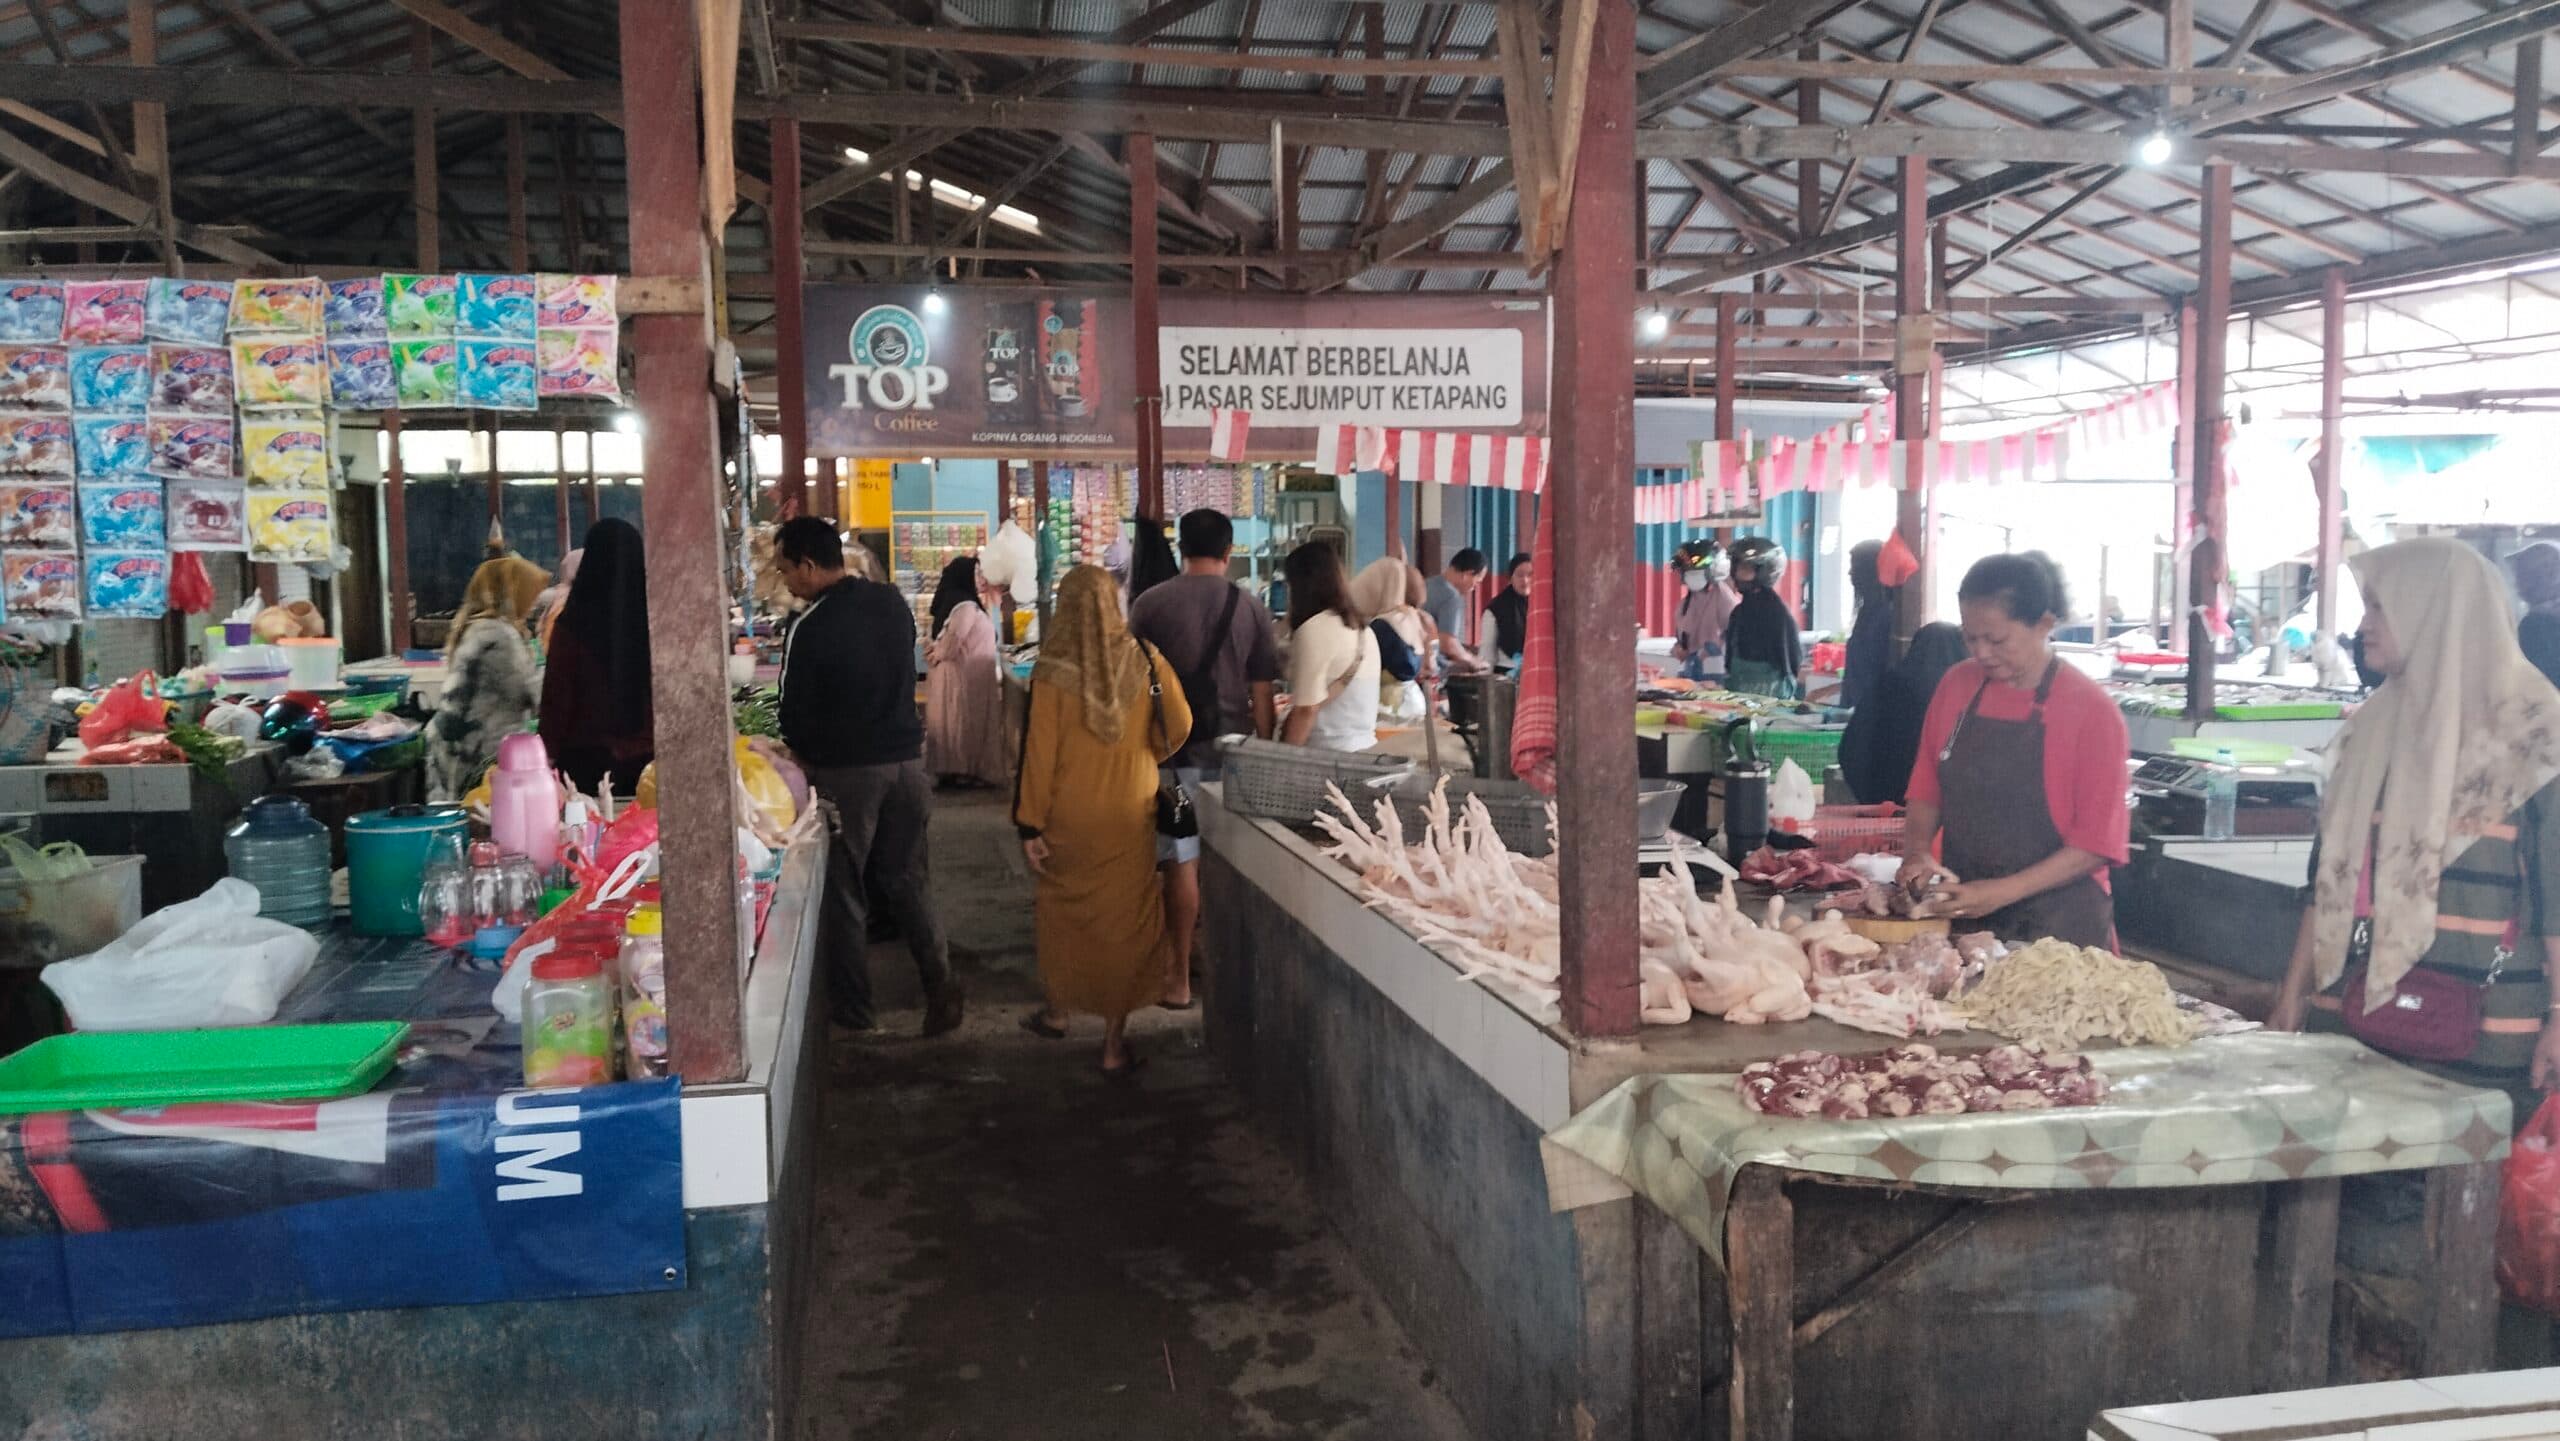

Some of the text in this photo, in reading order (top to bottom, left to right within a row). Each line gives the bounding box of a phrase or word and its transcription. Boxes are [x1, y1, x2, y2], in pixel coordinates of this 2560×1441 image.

[988, 347, 1020, 360] TOP
[1179, 344, 1471, 377] SELAMAT BERBELANJA
[828, 363, 949, 411] TOP
[1178, 384, 1254, 411] PASAR
[1260, 384, 1385, 411] SEJUMPUT
[1392, 384, 1507, 411] KETAPANG
[873, 410, 939, 432] Coffee
[972, 431, 1114, 444] KOPINYA ORANG INDONESIA
